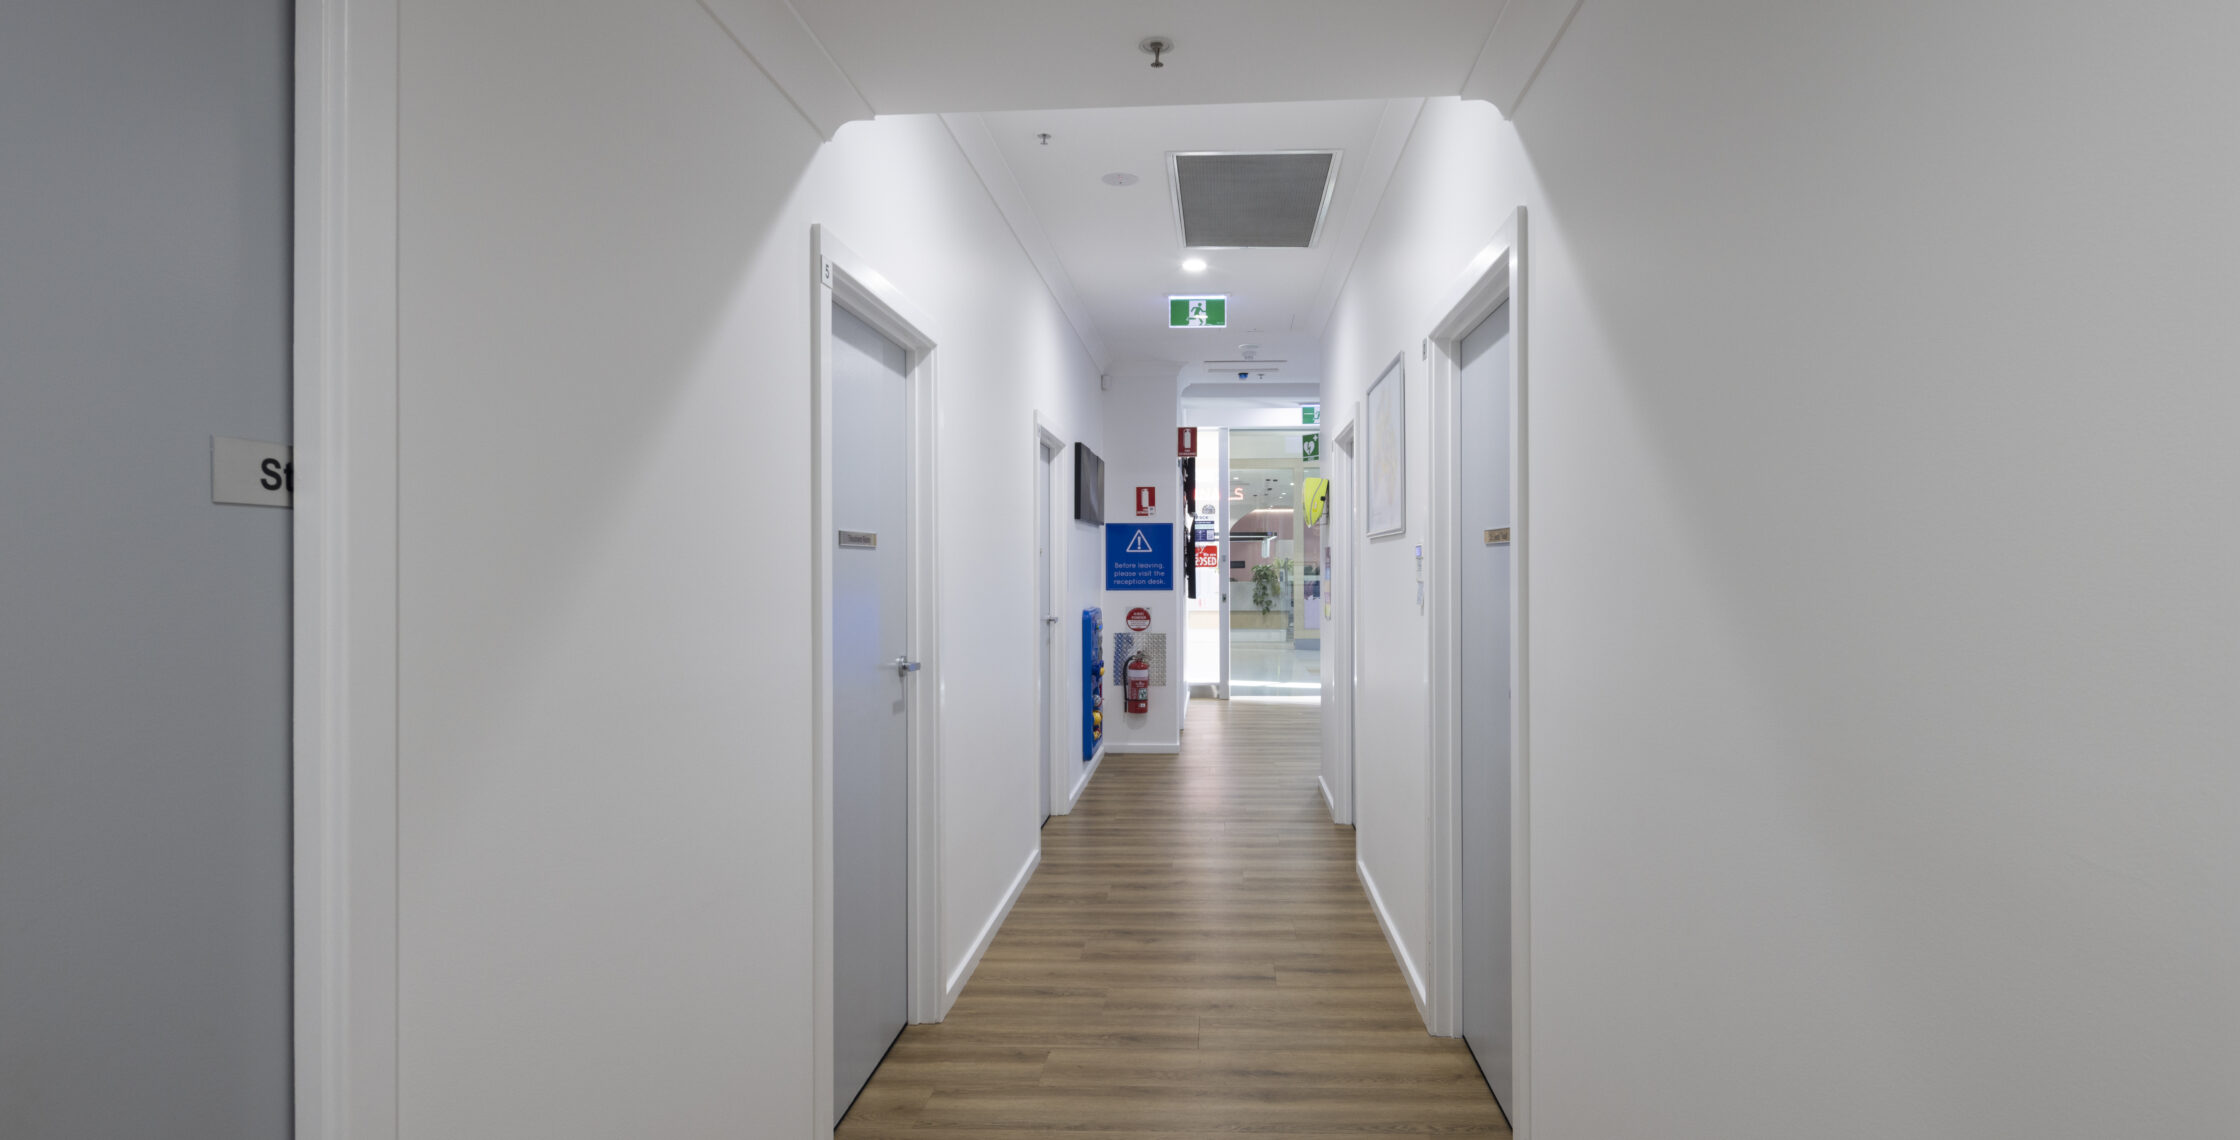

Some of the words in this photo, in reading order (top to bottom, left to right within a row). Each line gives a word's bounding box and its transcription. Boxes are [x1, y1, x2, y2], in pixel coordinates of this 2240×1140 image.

[825, 263, 830, 279] 5
[1113, 570, 1137, 578] please
[1113, 578, 1147, 586] reception
